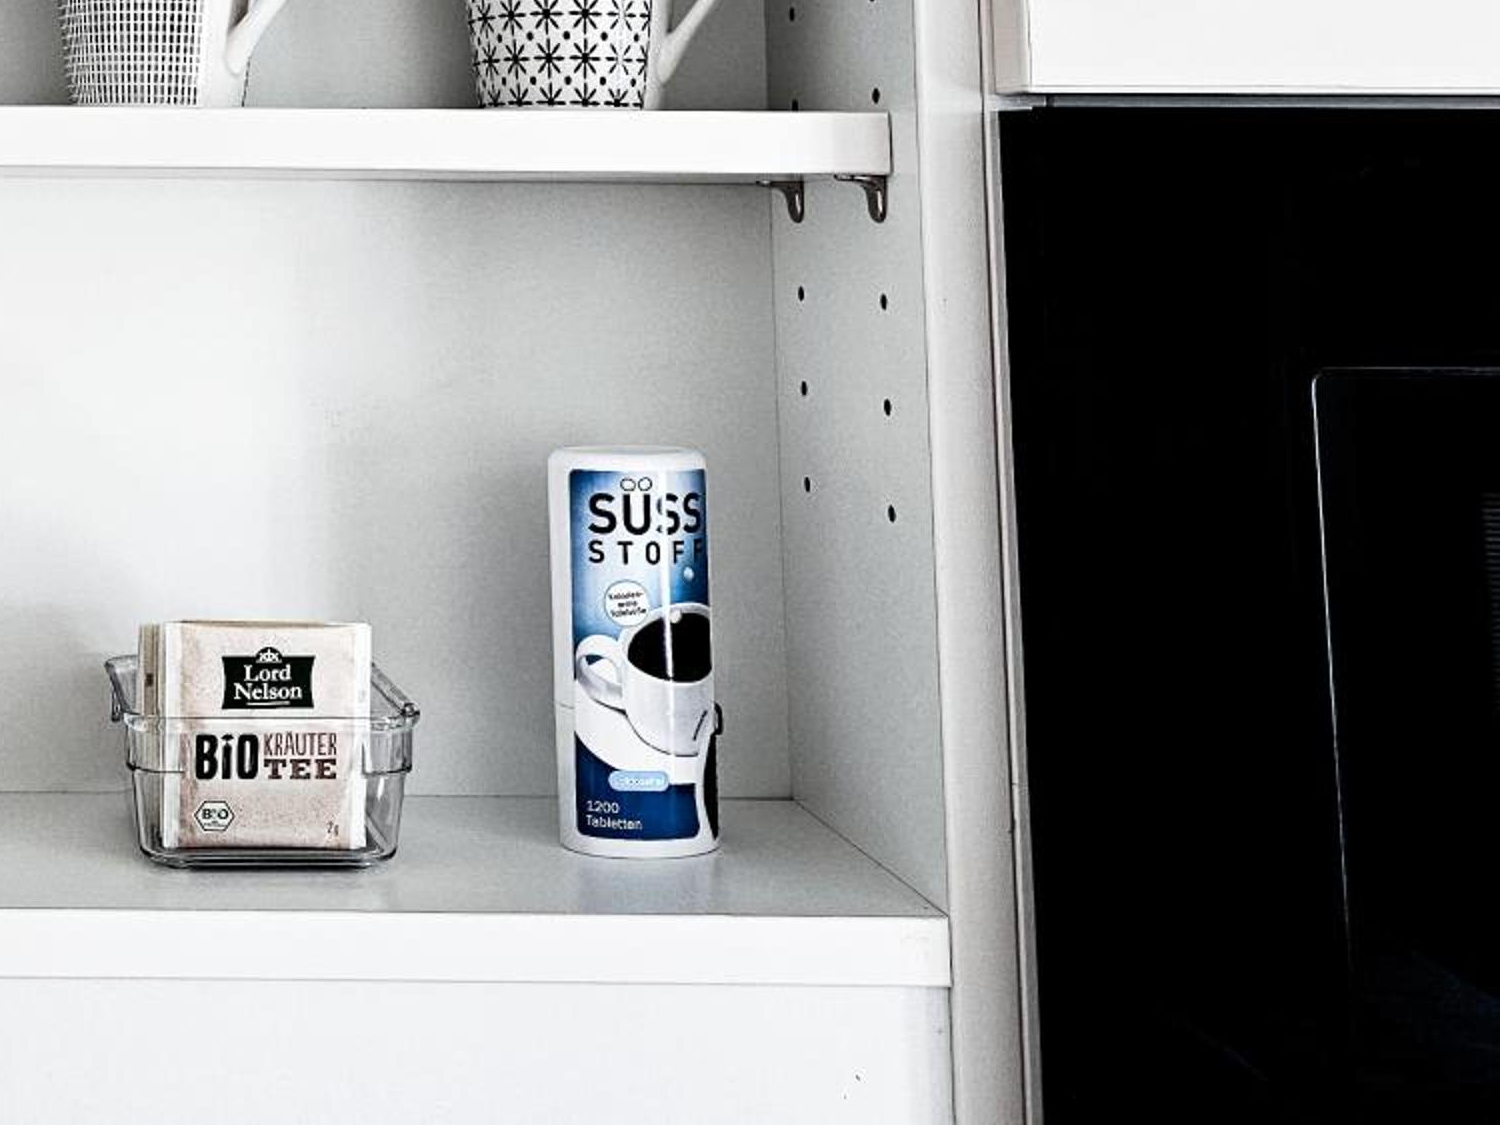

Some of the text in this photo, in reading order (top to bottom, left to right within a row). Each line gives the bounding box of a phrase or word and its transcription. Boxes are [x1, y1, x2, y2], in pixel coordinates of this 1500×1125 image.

[588, 540, 702, 565] STOFF
[243, 664, 292, 682] Lord
[233, 683, 303, 700] Nelson
[263, 730, 338, 756] KRÄUTER
[263, 759, 338, 780] TEE
[586, 800, 620, 814] 1200
